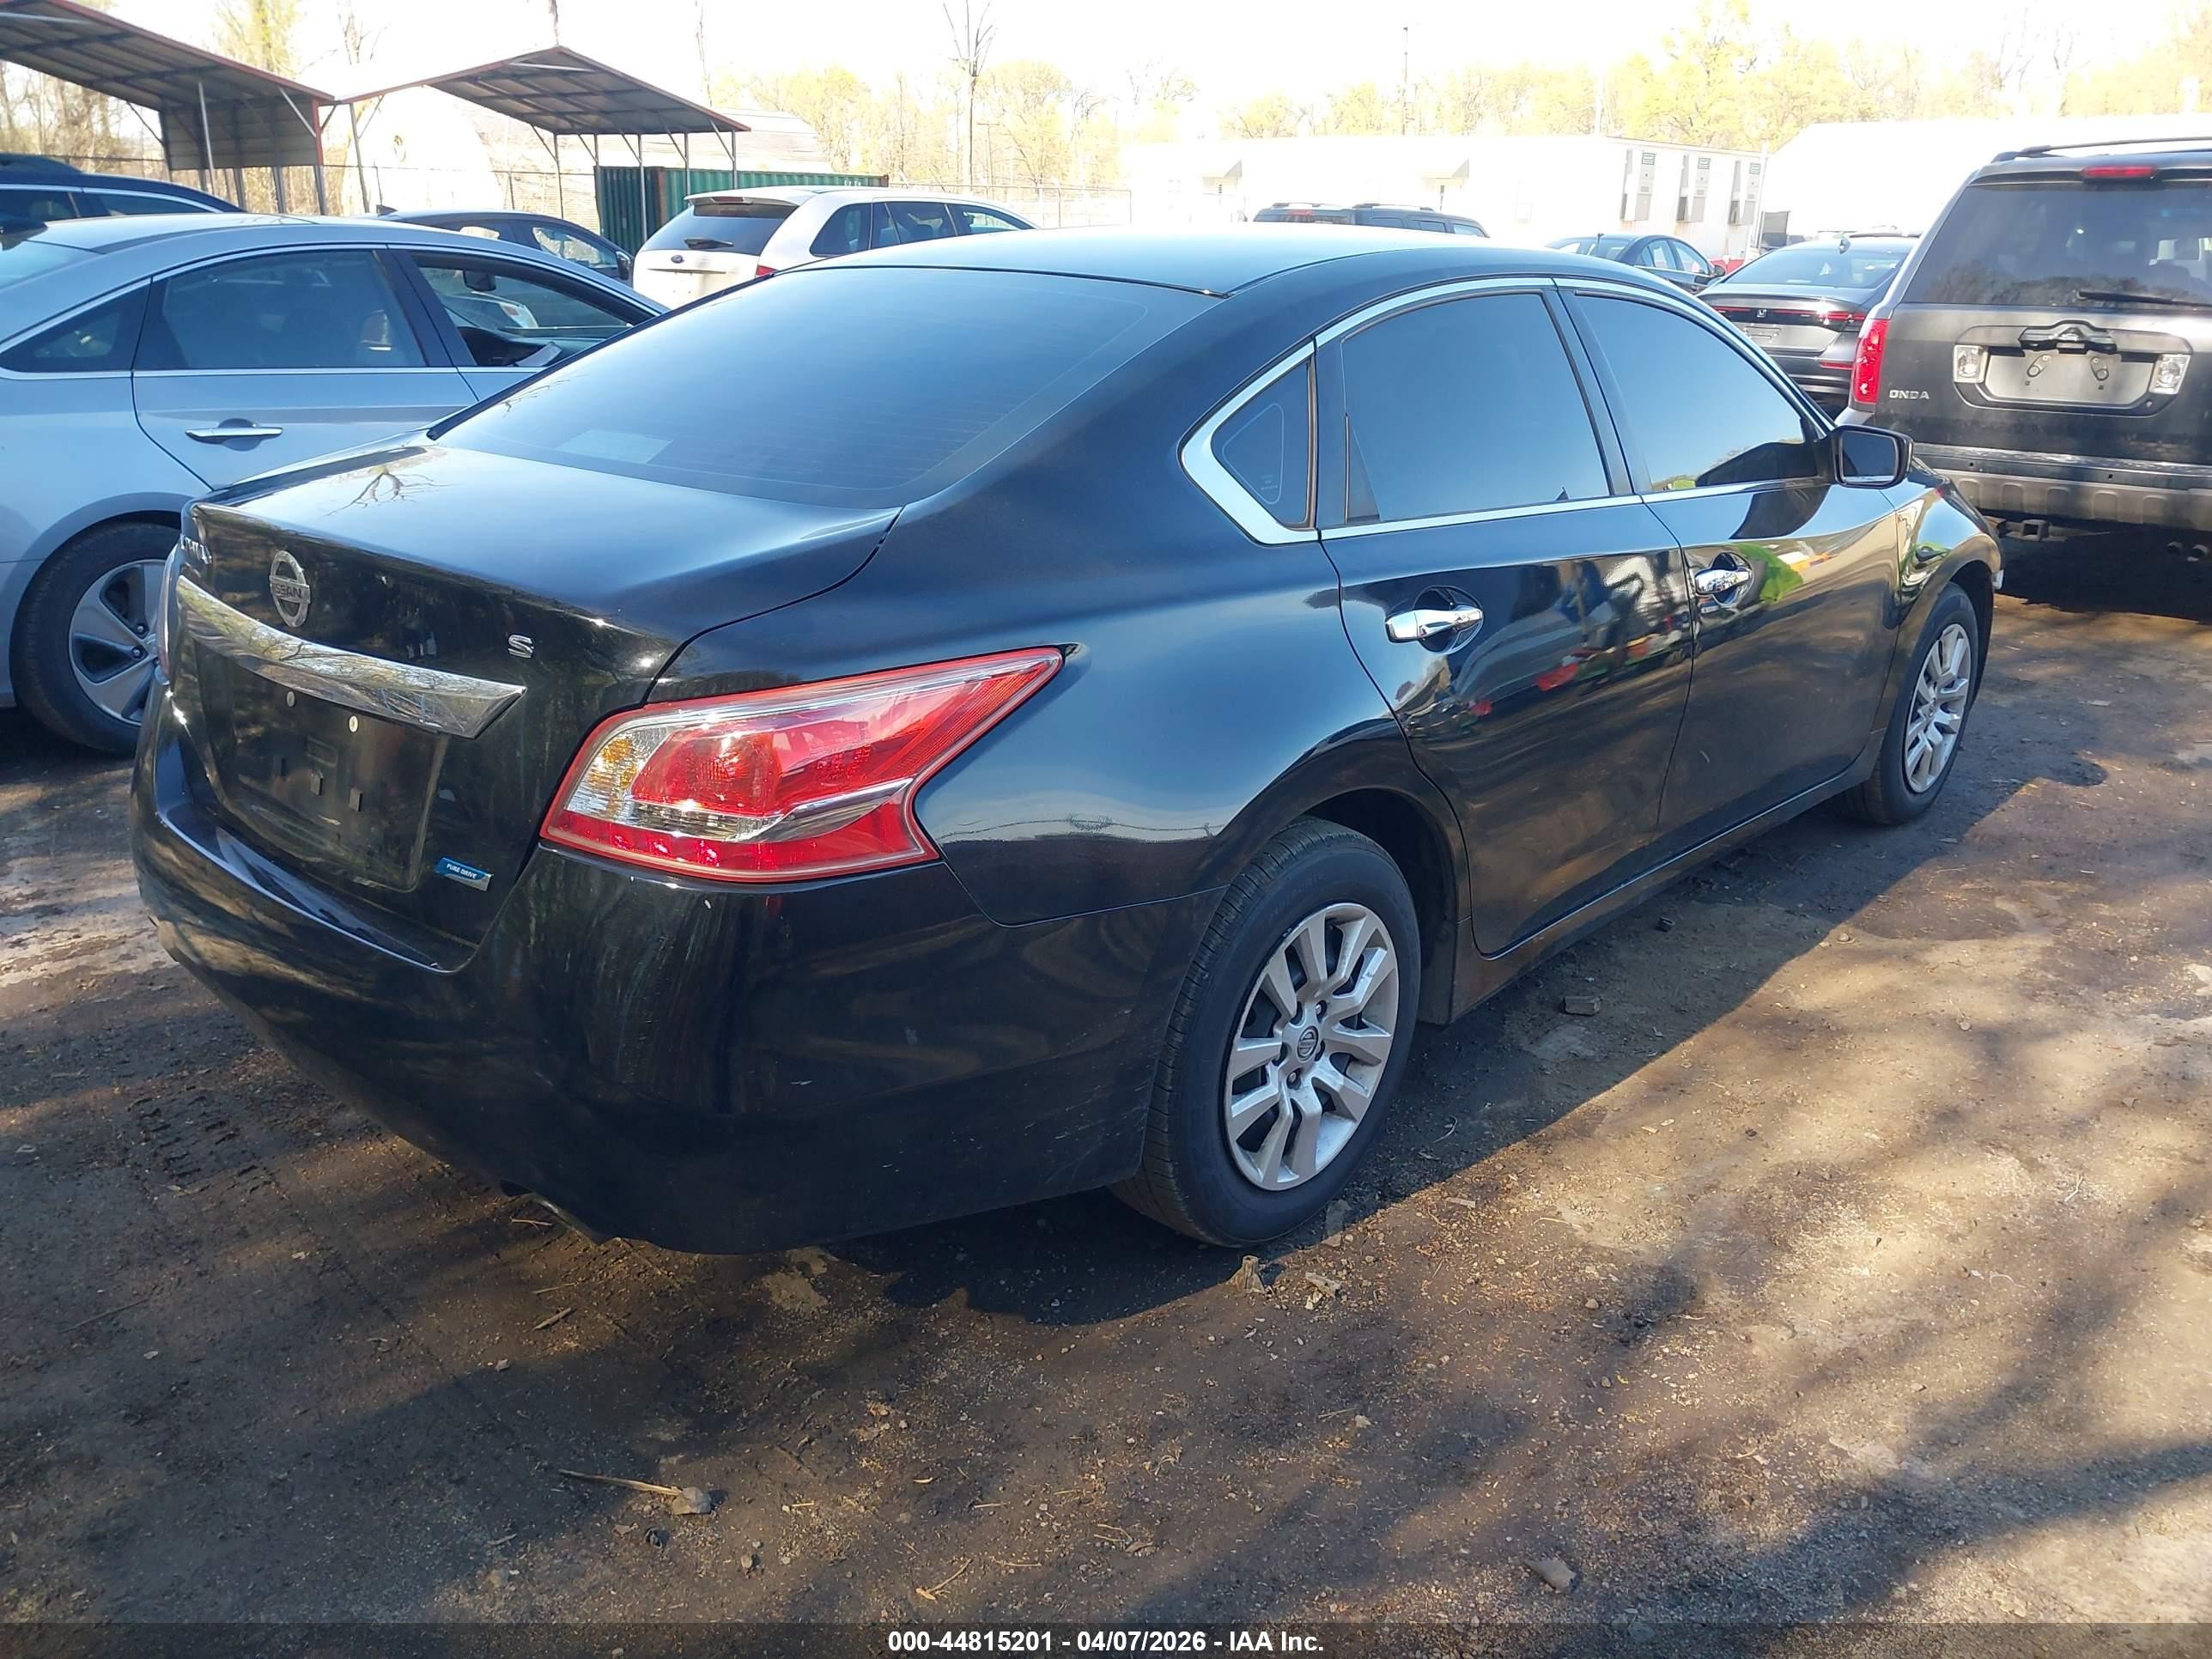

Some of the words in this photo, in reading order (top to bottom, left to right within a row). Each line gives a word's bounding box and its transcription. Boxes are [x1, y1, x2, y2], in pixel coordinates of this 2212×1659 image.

[1889, 389, 1929, 400] ONDA
[507, 635, 534, 659] S
[447, 863, 461, 873] PURE
[460, 868, 478, 879] DRIVE
